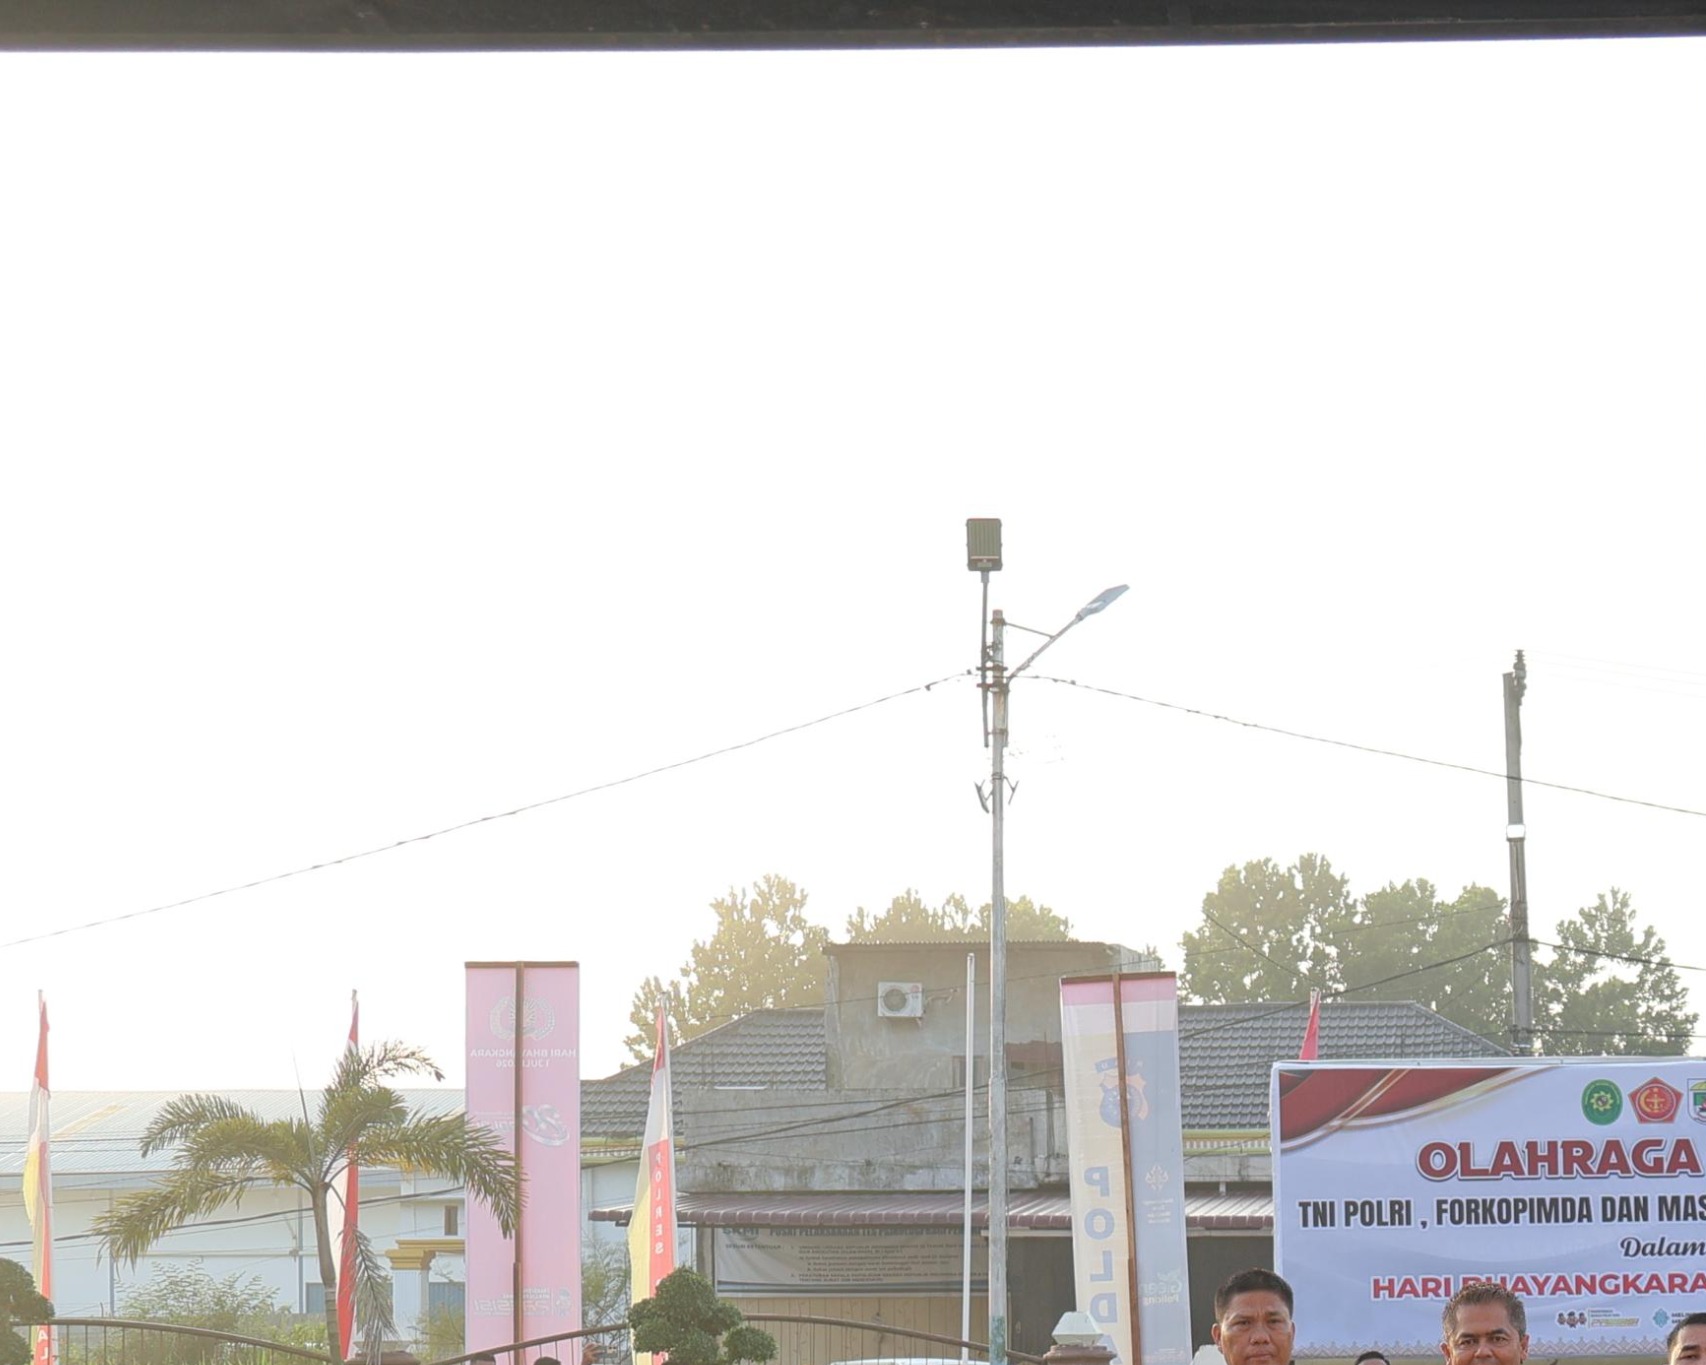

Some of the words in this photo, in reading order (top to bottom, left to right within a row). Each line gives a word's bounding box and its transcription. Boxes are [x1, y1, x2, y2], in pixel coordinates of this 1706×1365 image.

[1416, 1137, 1704, 1180] OLAHRAGA
[1299, 1201, 1335, 1228] TNI
[1344, 1199, 1412, 1227] POLRI
[1435, 1197, 1593, 1226] FORKOPIMDA
[1601, 1196, 1649, 1223] DAN
[1372, 1276, 1450, 1299] HARI
